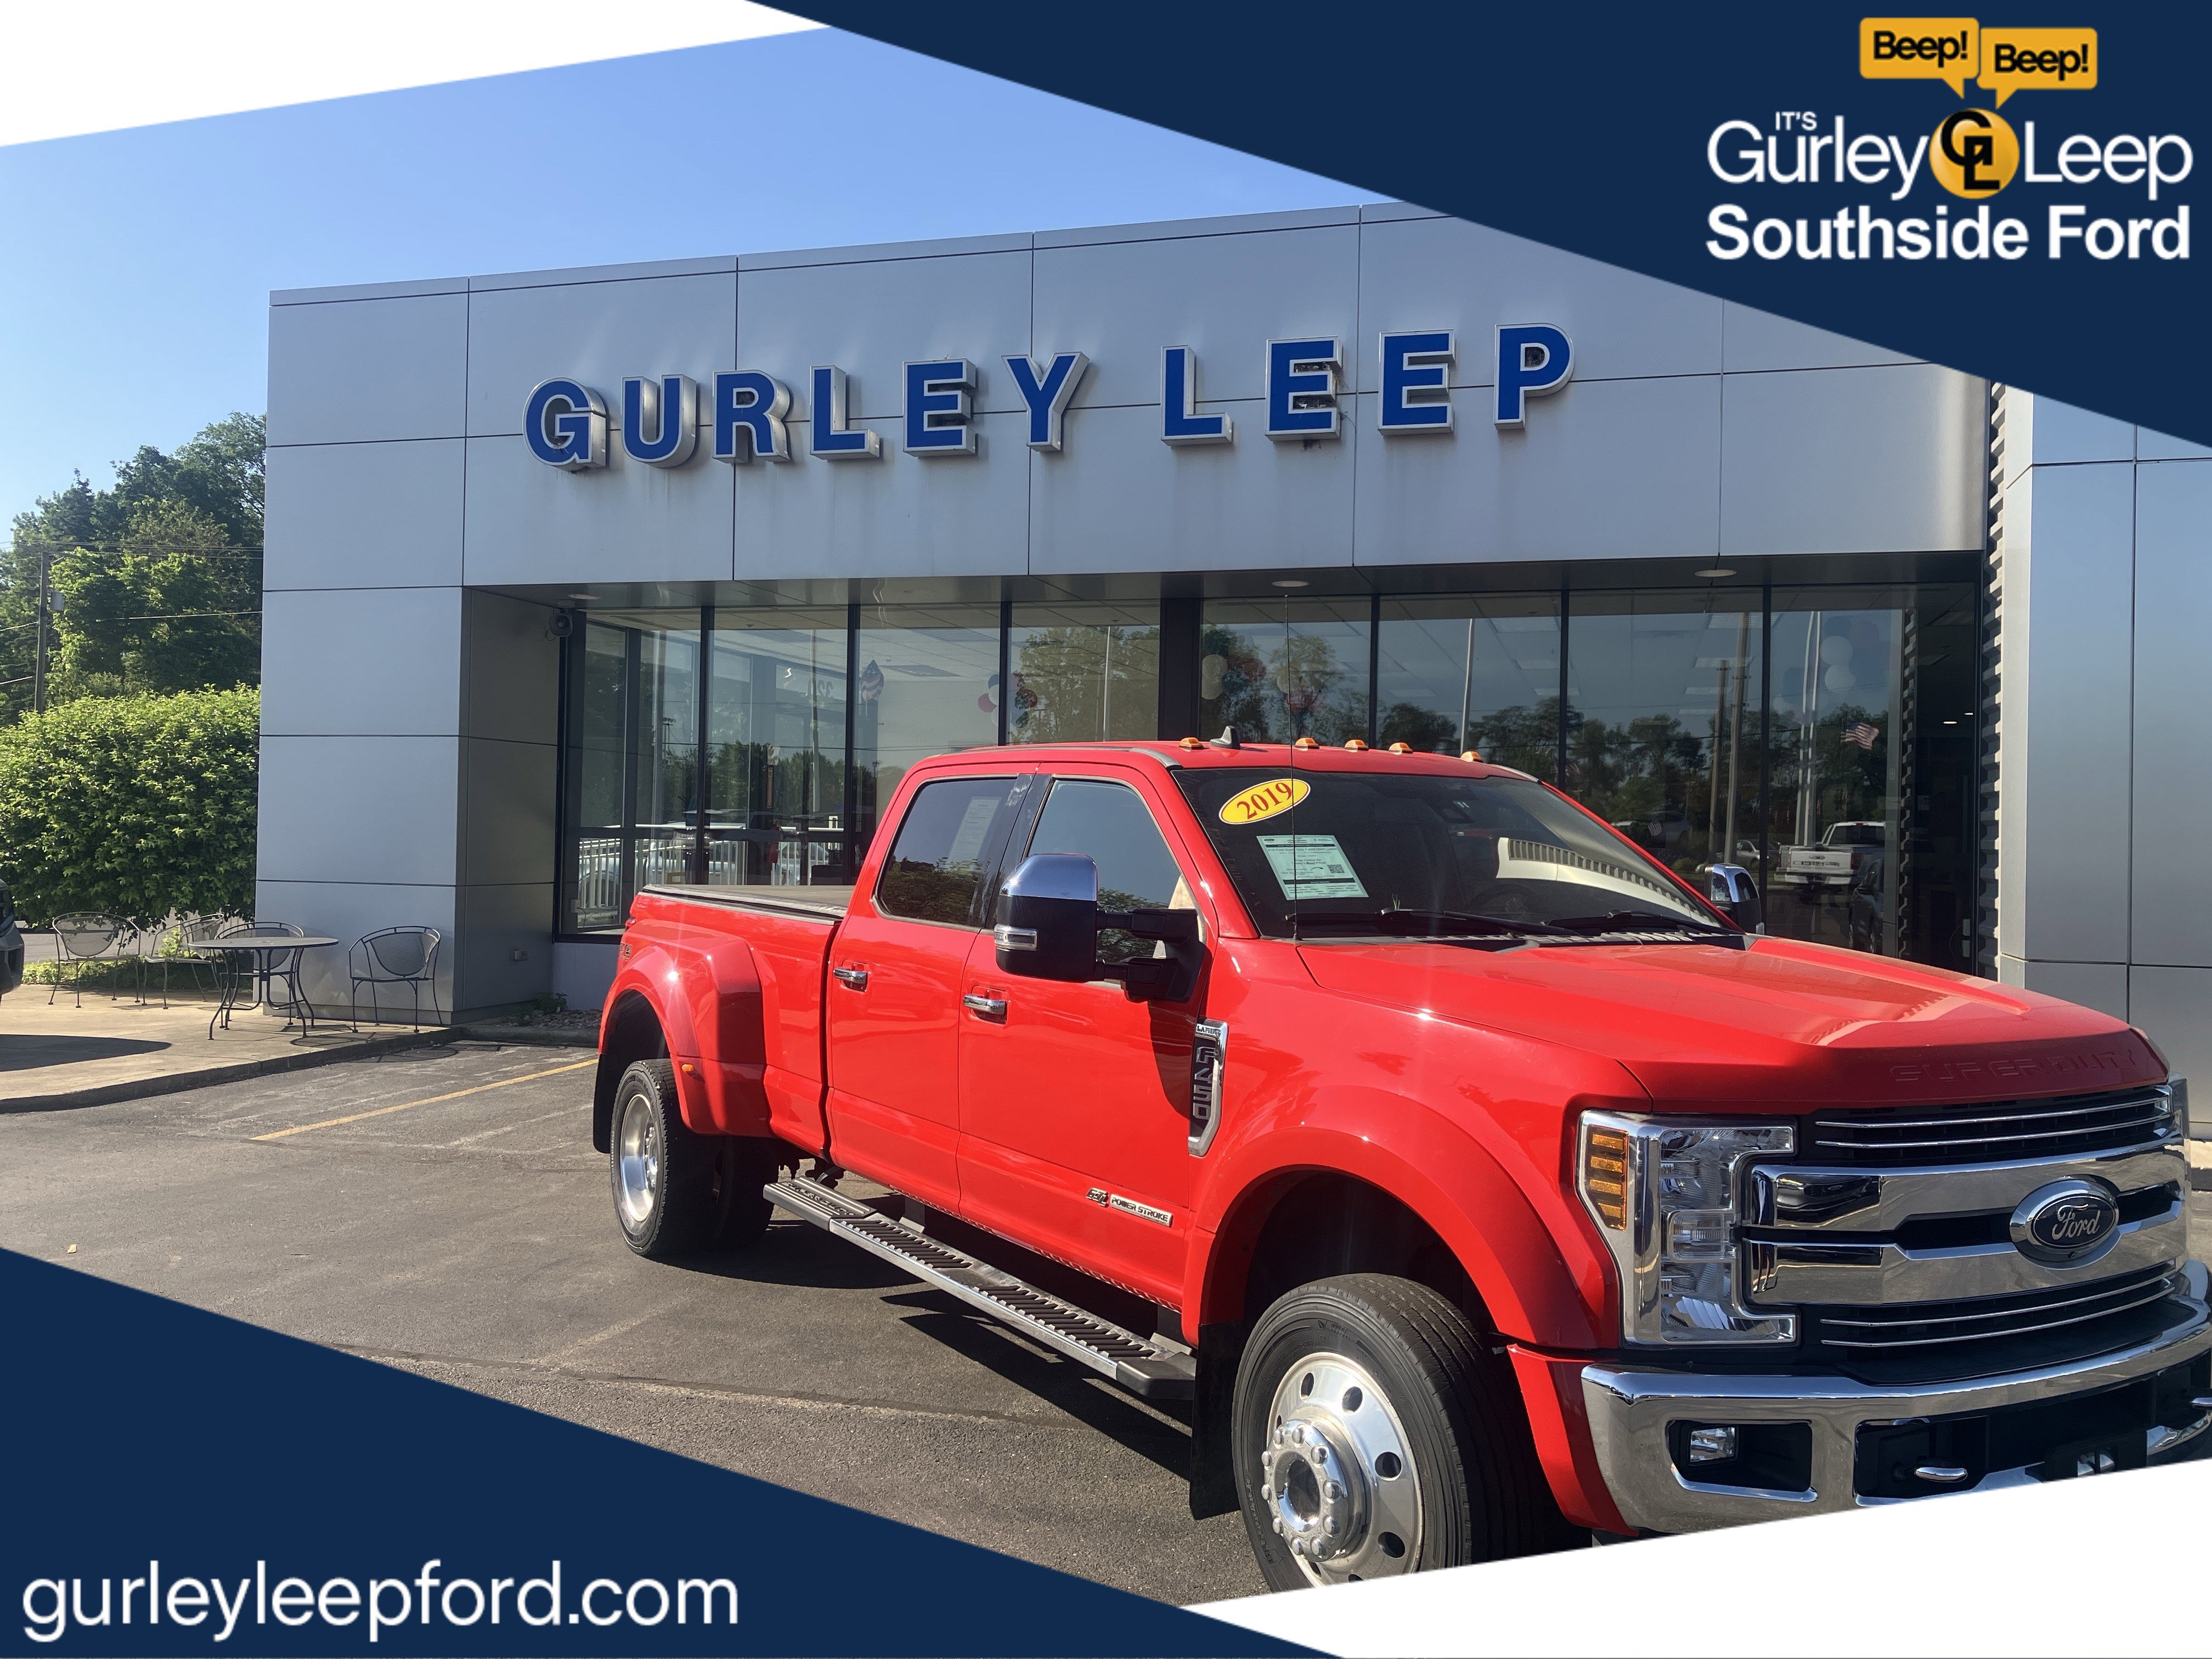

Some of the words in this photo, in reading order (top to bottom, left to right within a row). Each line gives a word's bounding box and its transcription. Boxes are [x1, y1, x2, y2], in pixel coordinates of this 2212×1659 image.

[522, 351, 1089, 470] GURLEY
[1160, 323, 1575, 447] LEEP
[1237, 781, 1293, 820] 2019
[1111, 1196, 1136, 1211] POWER
[1138, 1206, 1169, 1222] STROKE
[2051, 1203, 2101, 1240] Ford
